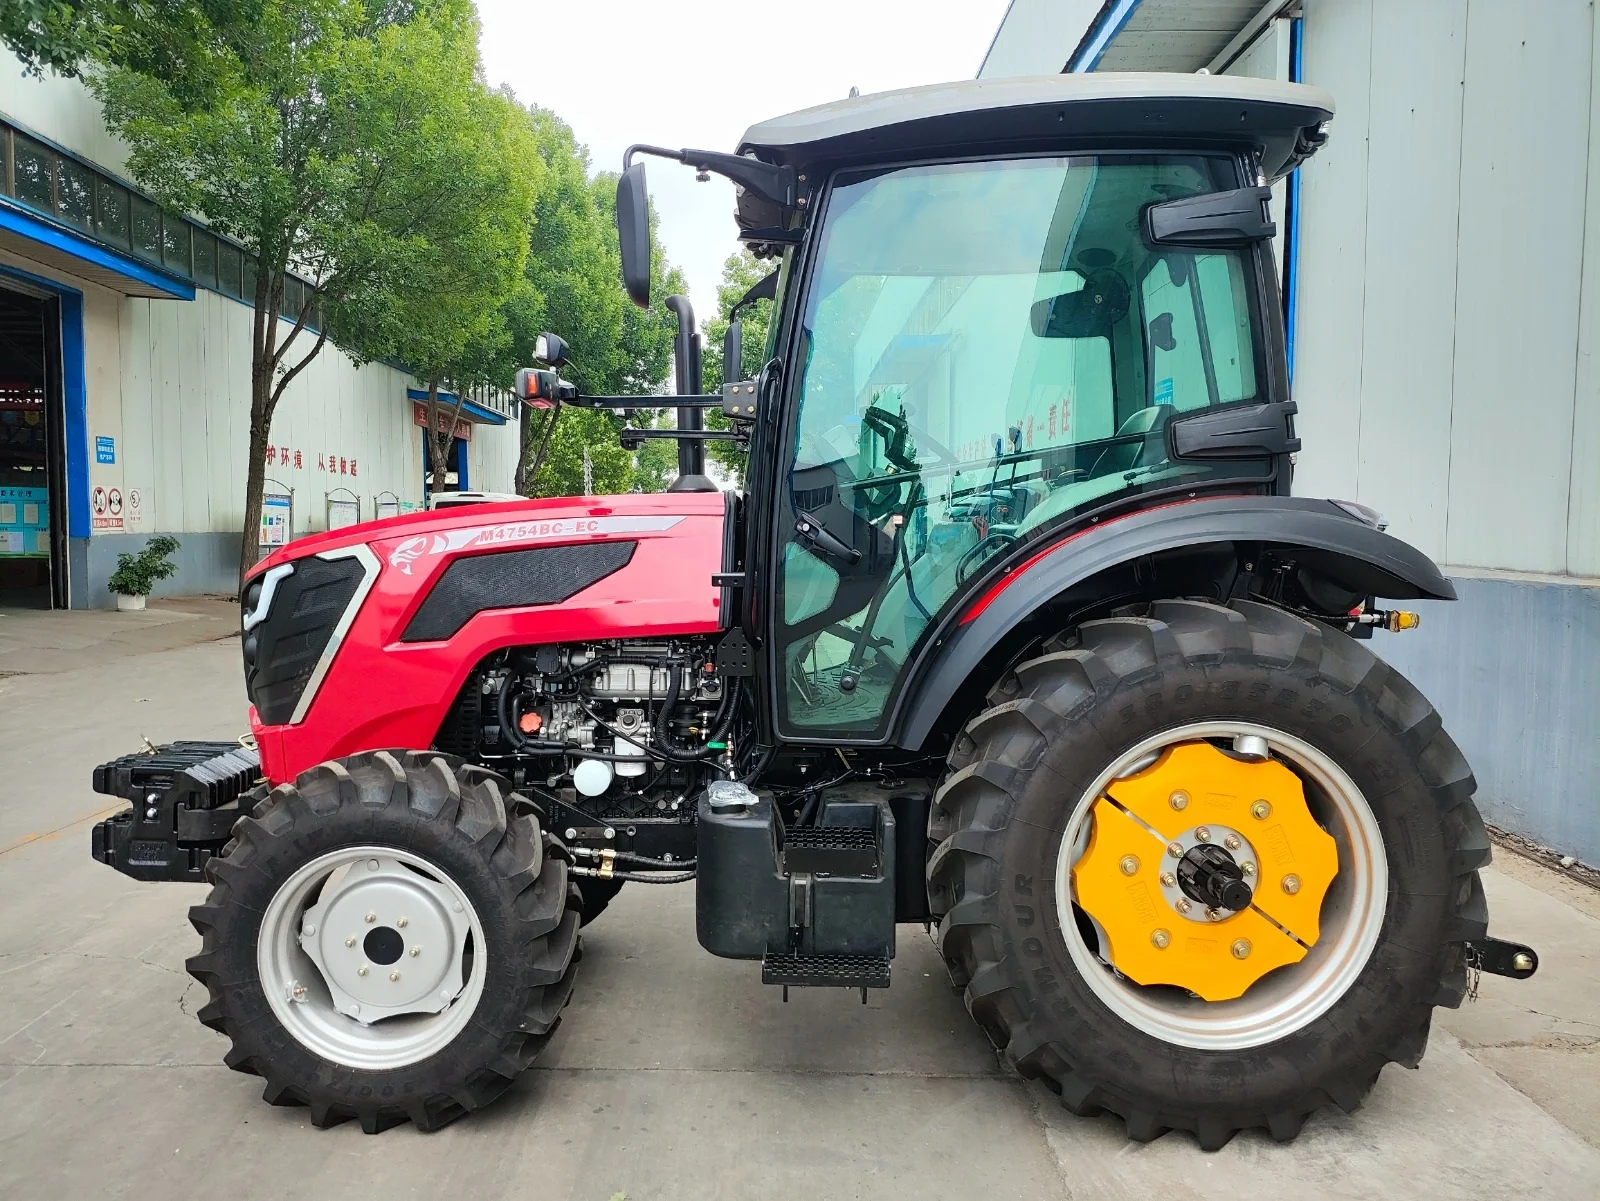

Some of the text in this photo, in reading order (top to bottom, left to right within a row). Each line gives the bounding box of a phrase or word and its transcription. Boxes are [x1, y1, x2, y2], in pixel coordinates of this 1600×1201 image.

[317, 452, 357, 477] 从我做起
[479, 520, 599, 542] M4754BC-EC
[1012, 872, 1098, 1050] ARMOUR
